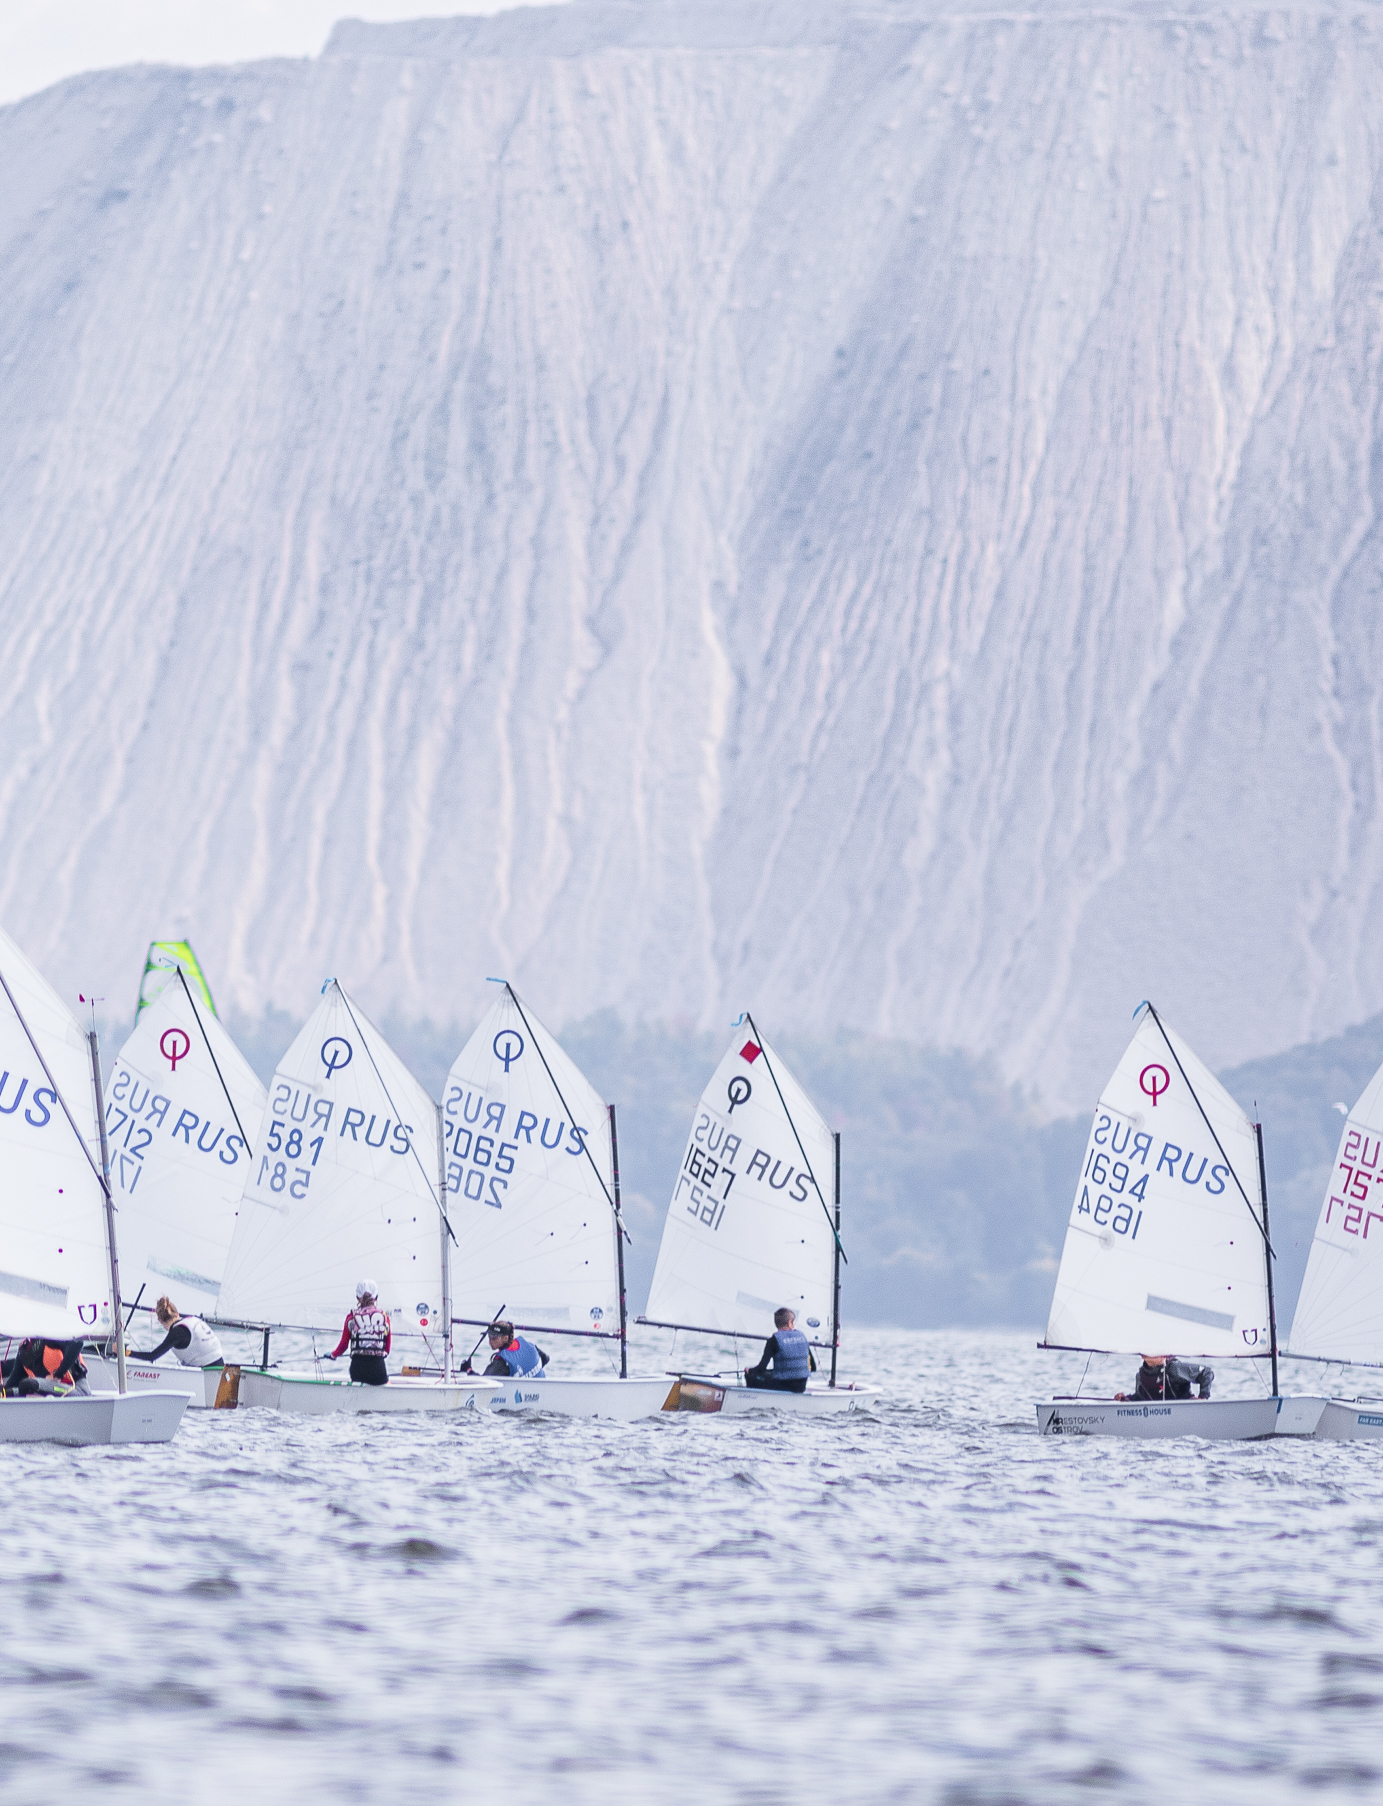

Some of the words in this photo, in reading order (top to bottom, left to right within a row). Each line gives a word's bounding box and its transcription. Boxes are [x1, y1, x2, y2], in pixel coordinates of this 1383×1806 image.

[171, 1108, 244, 1165] RUS
[266, 1120, 324, 1166] 581
[339, 1107, 414, 1155] RUS
[514, 1110, 589, 1156] RUS
[684, 1143, 736, 1200] 1627
[746, 1149, 816, 1202] RUS
[1084, 1148, 1150, 1203] 1694
[1156, 1142, 1230, 1195] RUS
[1052, 1416, 1105, 1425] KRESTOVSKY
[1117, 1409, 1142, 1417] FITNESS
[1149, 1407, 1172, 1416] HOUSE
